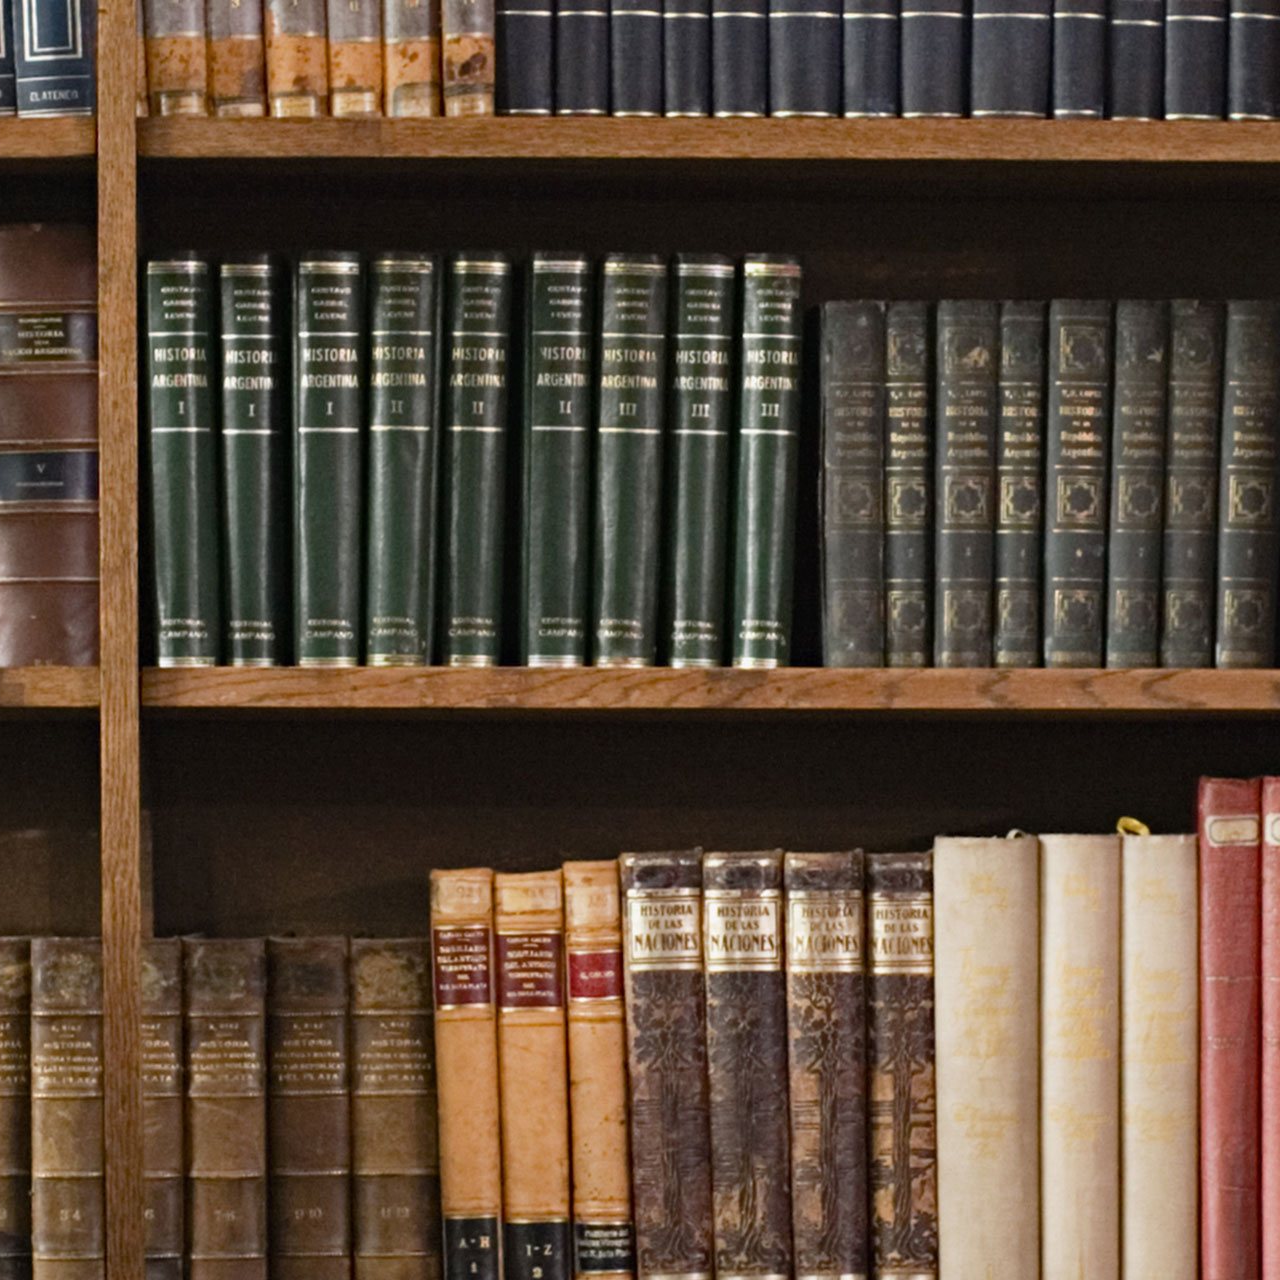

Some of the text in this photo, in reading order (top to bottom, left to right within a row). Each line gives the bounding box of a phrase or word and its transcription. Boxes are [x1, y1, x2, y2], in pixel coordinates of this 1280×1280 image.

[30, 89, 79, 102] EL ATENEO
[154, 348, 206, 361] HISTORIA
[226, 351, 276, 364] HISTORI
[303, 348, 357, 361] HISTORIA
[372, 347, 425, 360] HISTORIA
[452, 347, 505, 361] HISTORIA
[541, 347, 587, 361] HISTORI
[604, 348, 656, 362] HISTORIA
[676, 350, 728, 365] HISTORIA
[747, 350, 798, 365] HISTORIA
[152, 374, 208, 387] ARGENTINA
[301, 374, 359, 388] ARGENTINA
[371, 373, 426, 387] ARGENTINA
[450, 374, 505, 387] ARGENTINA
[601, 375, 657, 388] ARGENTINA
[673, 376, 728, 391] ARGENTINA
[178, 401, 185, 415] I
[248, 404, 255, 416] I
[327, 402, 334, 415] I
[390, 401, 403, 414] II
[472, 402, 484, 415] II
[559, 401, 571, 414] II
[620, 403, 637, 416] III
[691, 403, 709, 418] III
[761, 403, 780, 417] III
[640, 904, 693, 917] HISTORIA
[717, 905, 770, 917] HISTORIA
[802, 905, 854, 917] HISTORIA
[876, 907, 929, 920] HISTORIA
[649, 919, 683, 930] DE LAS
[725, 920, 759, 931] DE LAS
[810, 921, 844, 931] DE LAS
[884, 923, 919, 932] DE LAS
[635, 933, 699, 951] NACIONES
[711, 933, 775, 952] NACIONES
[795, 934, 859, 953] NACIONES
[872, 936, 933, 954] NACIONES
